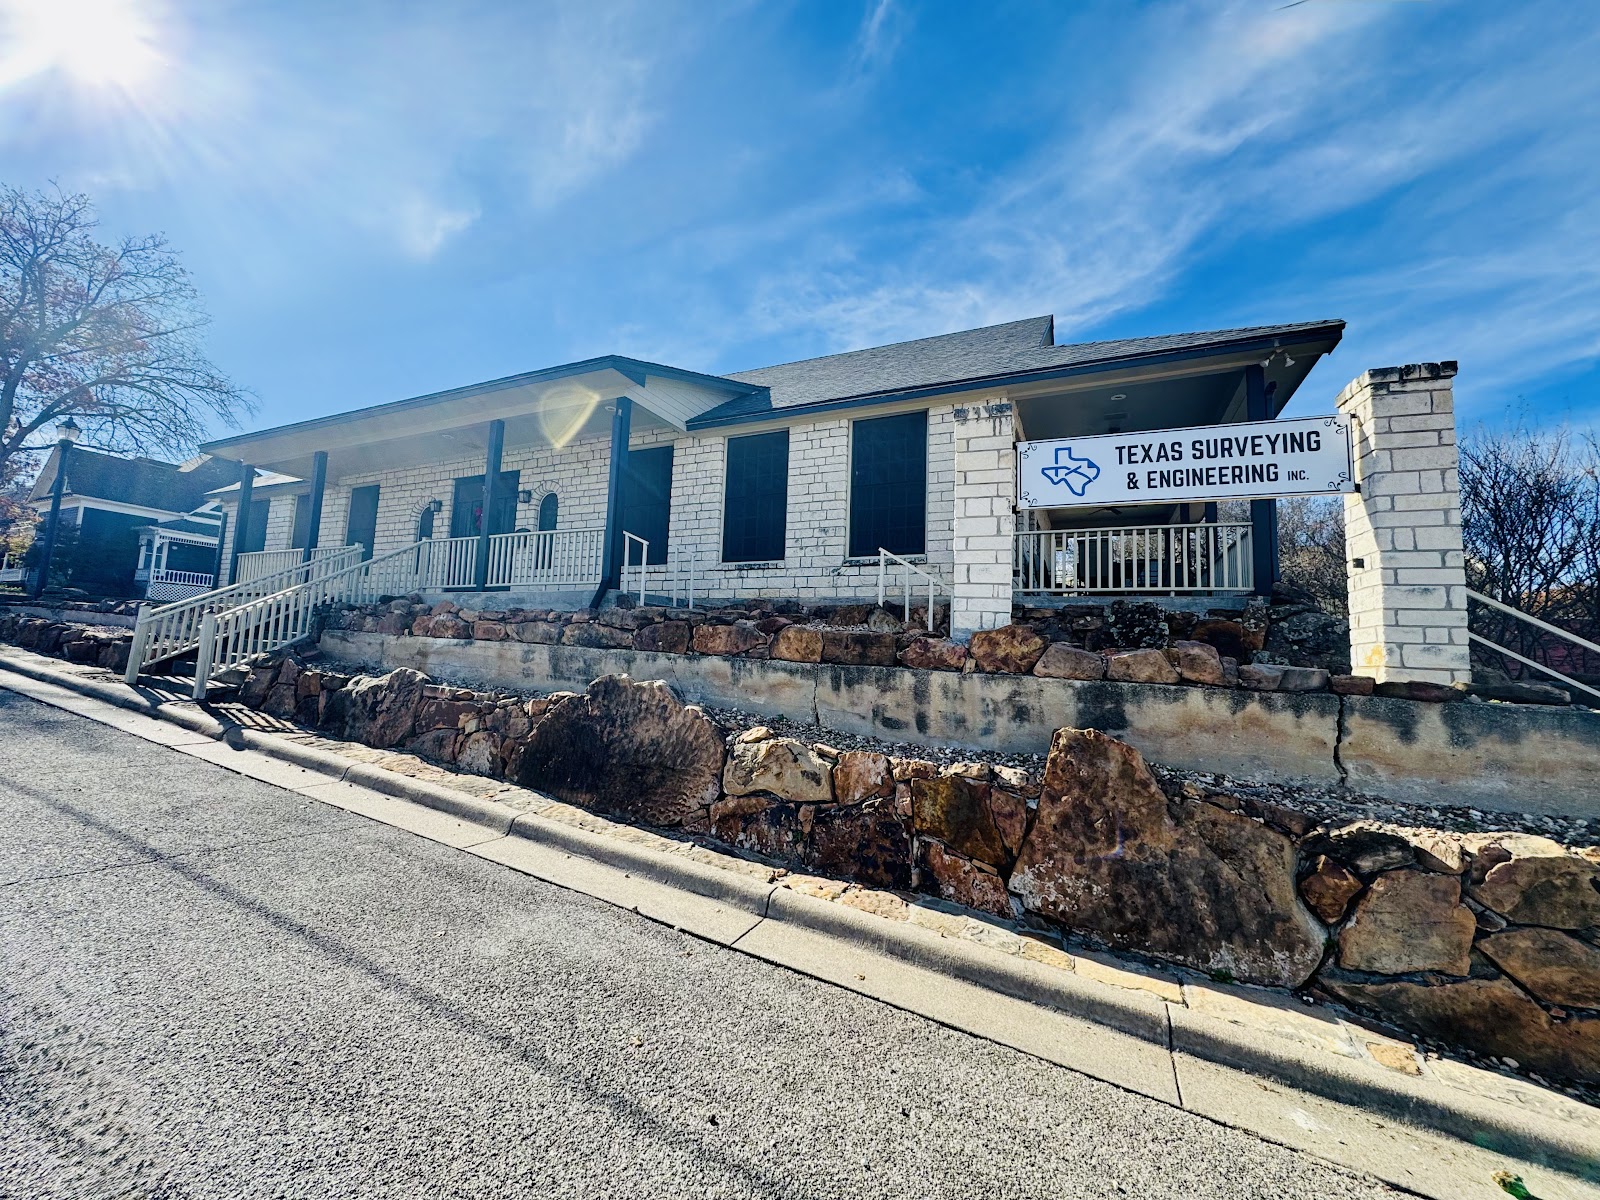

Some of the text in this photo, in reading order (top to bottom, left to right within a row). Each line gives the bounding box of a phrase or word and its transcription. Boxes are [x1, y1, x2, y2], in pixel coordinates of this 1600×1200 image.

[1115, 430, 1321, 465] TEXAS SURVEYING
[1127, 463, 1310, 490] & ENGINEERING INC.
